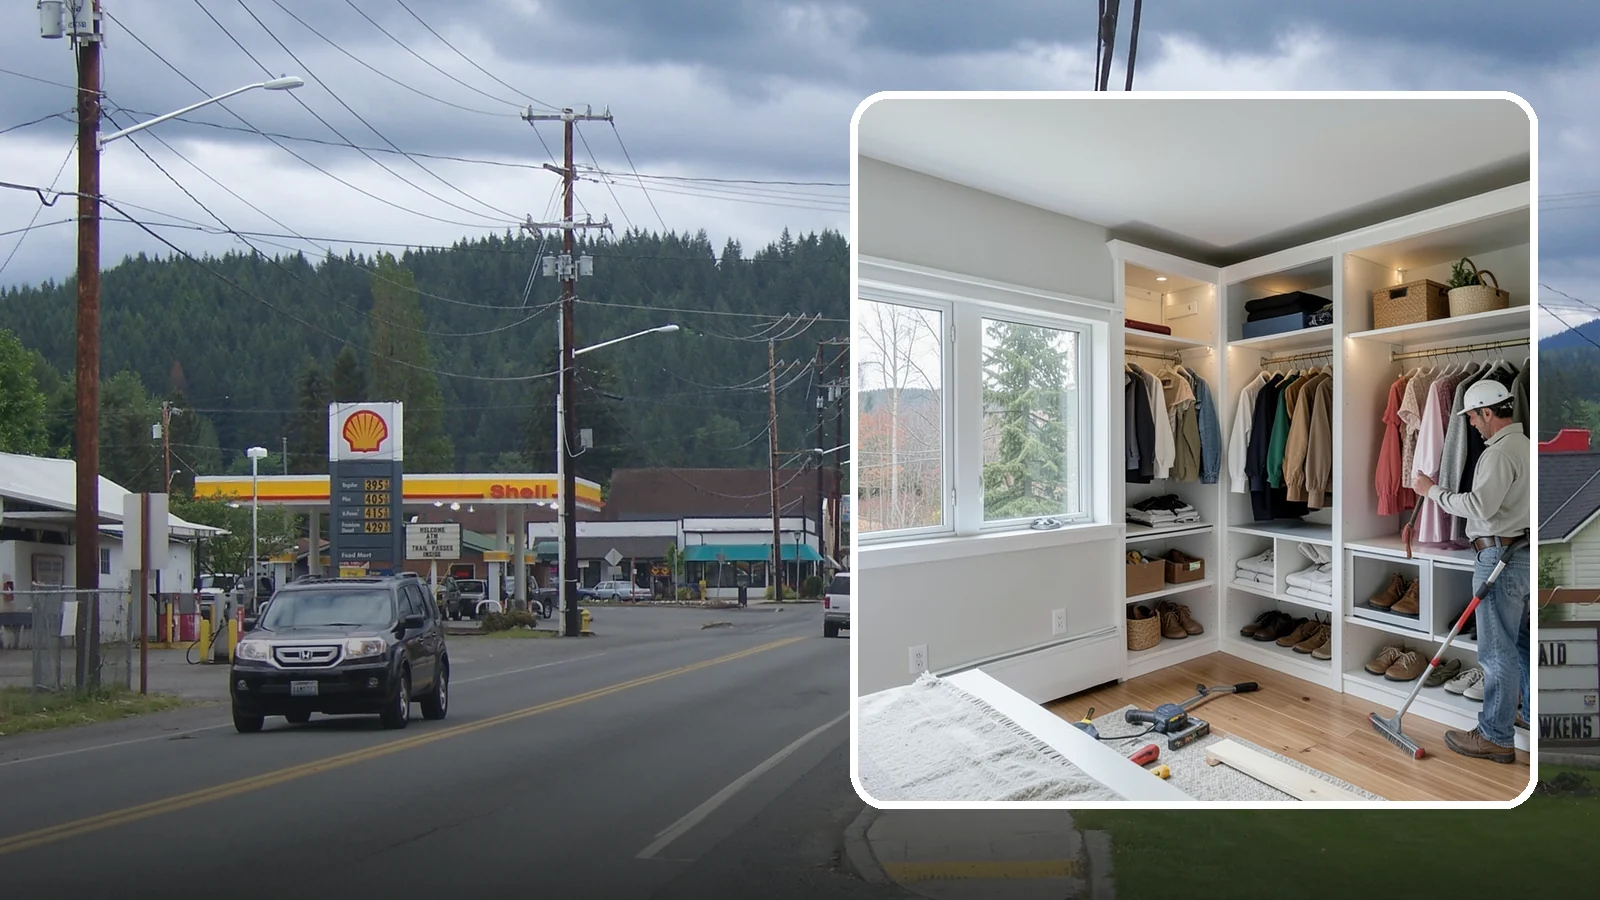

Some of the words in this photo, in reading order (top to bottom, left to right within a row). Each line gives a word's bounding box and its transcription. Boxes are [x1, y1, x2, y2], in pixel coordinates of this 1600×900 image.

[366, 480, 384, 490] 395
[490, 484, 547, 499] Shell
[366, 494, 384, 504] 405
[366, 508, 384, 518] 415
[366, 522, 384, 533] 429
